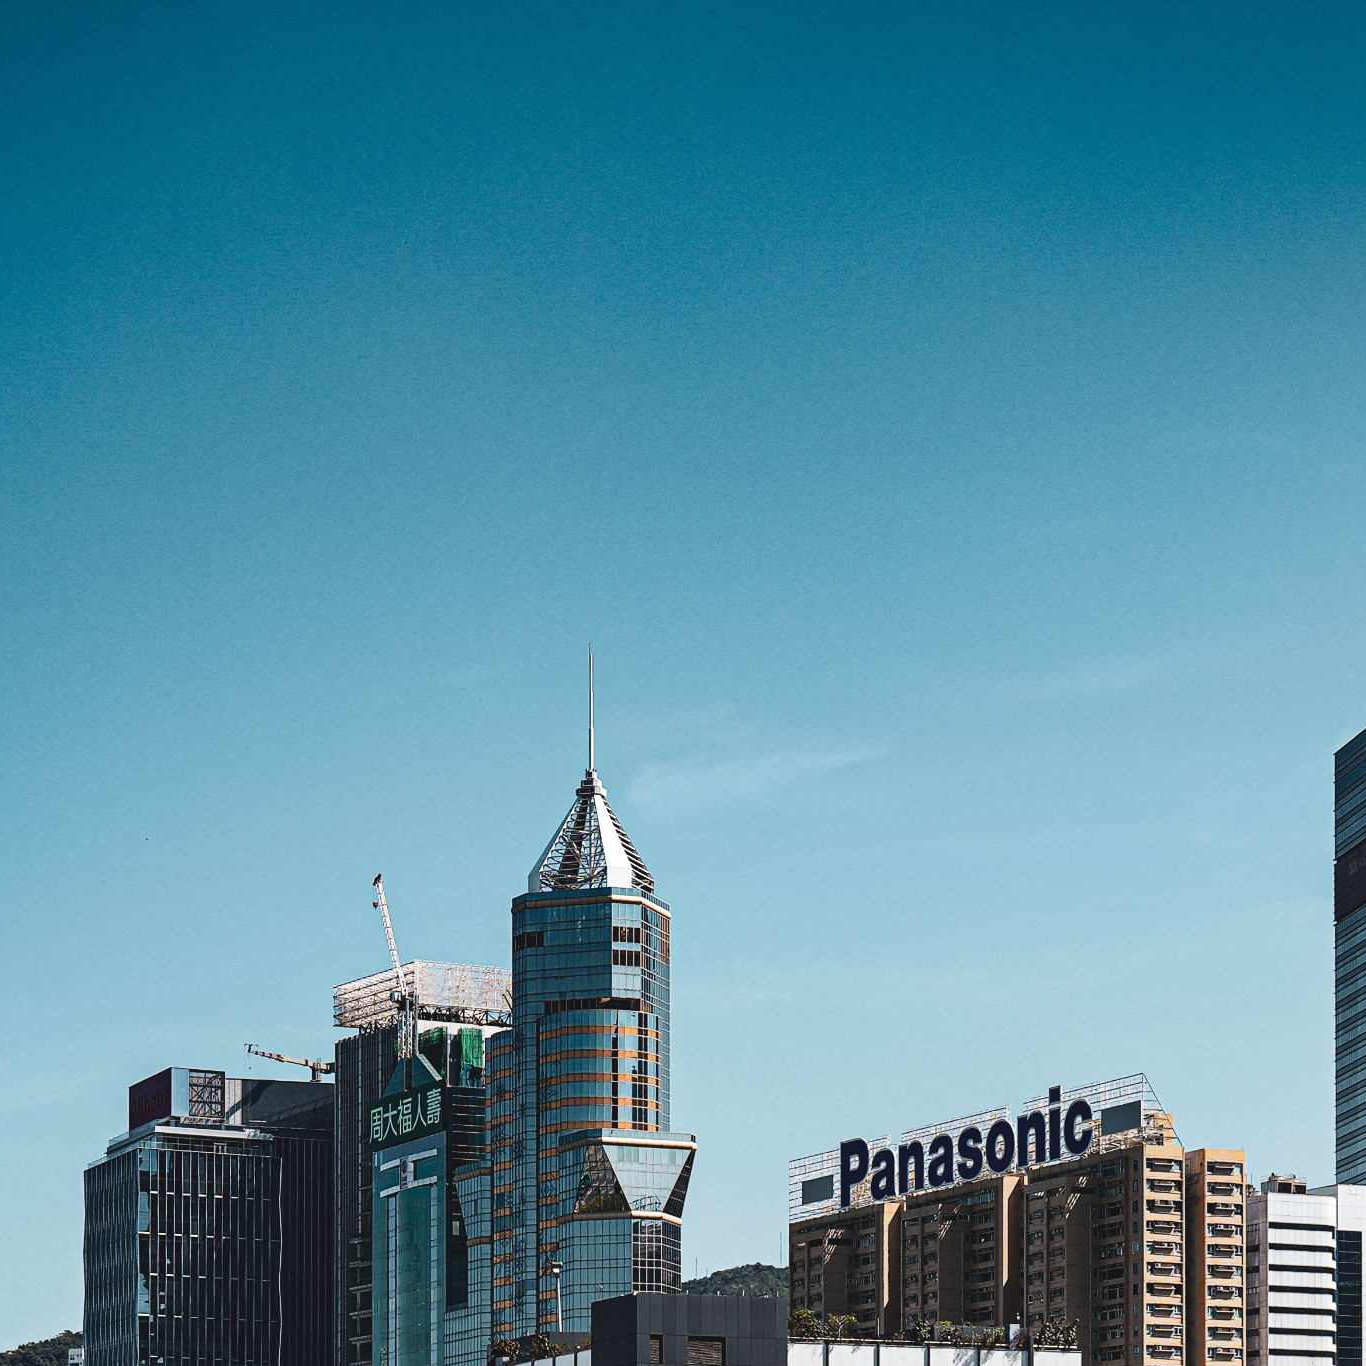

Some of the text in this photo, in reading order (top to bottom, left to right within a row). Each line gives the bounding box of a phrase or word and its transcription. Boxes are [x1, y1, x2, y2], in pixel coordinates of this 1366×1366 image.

[131, 1087, 170, 1118] Alibaba
[369, 1088, 442, 1144] 周大福人壽
[840, 1085, 1093, 1209] Panasonic
